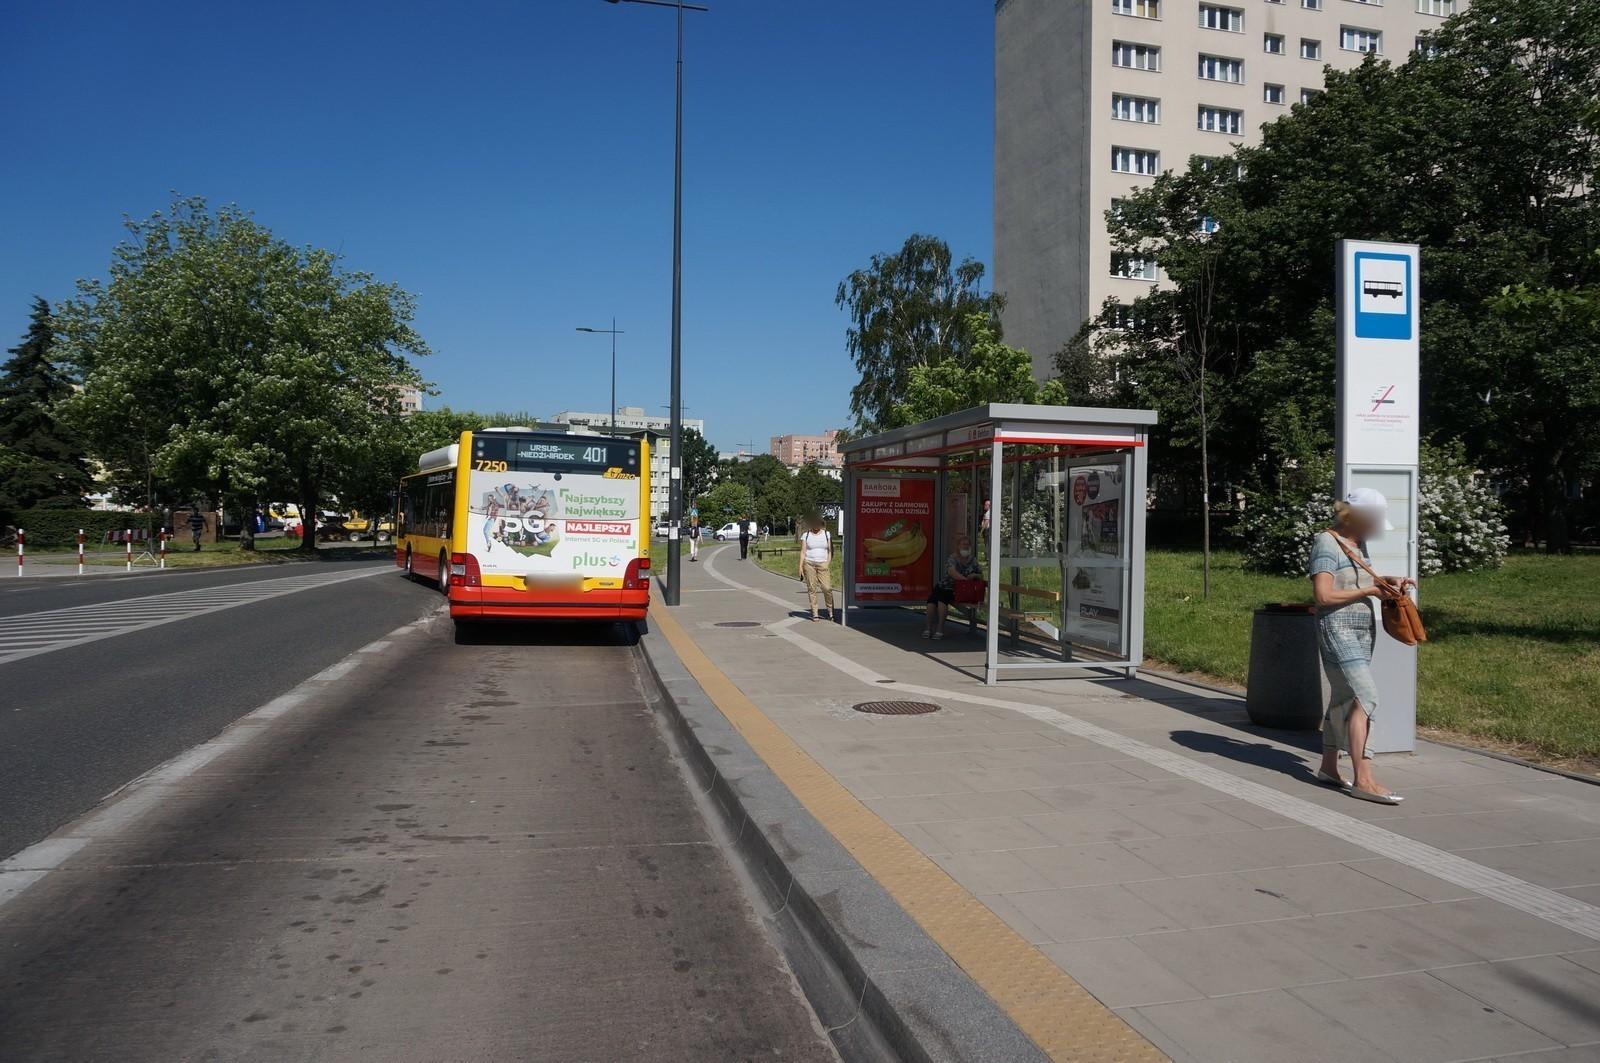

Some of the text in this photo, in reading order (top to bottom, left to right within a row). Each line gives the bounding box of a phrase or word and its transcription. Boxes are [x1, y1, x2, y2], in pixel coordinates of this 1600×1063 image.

[583, 446, 607, 463] 401
[475, 460, 508, 472] 7250
[565, 494, 625, 506] Najszybszy
[565, 506, 626, 518] Największy
[567, 522, 630, 534] NAJLEPSZY
[573, 551, 607, 569] plus
